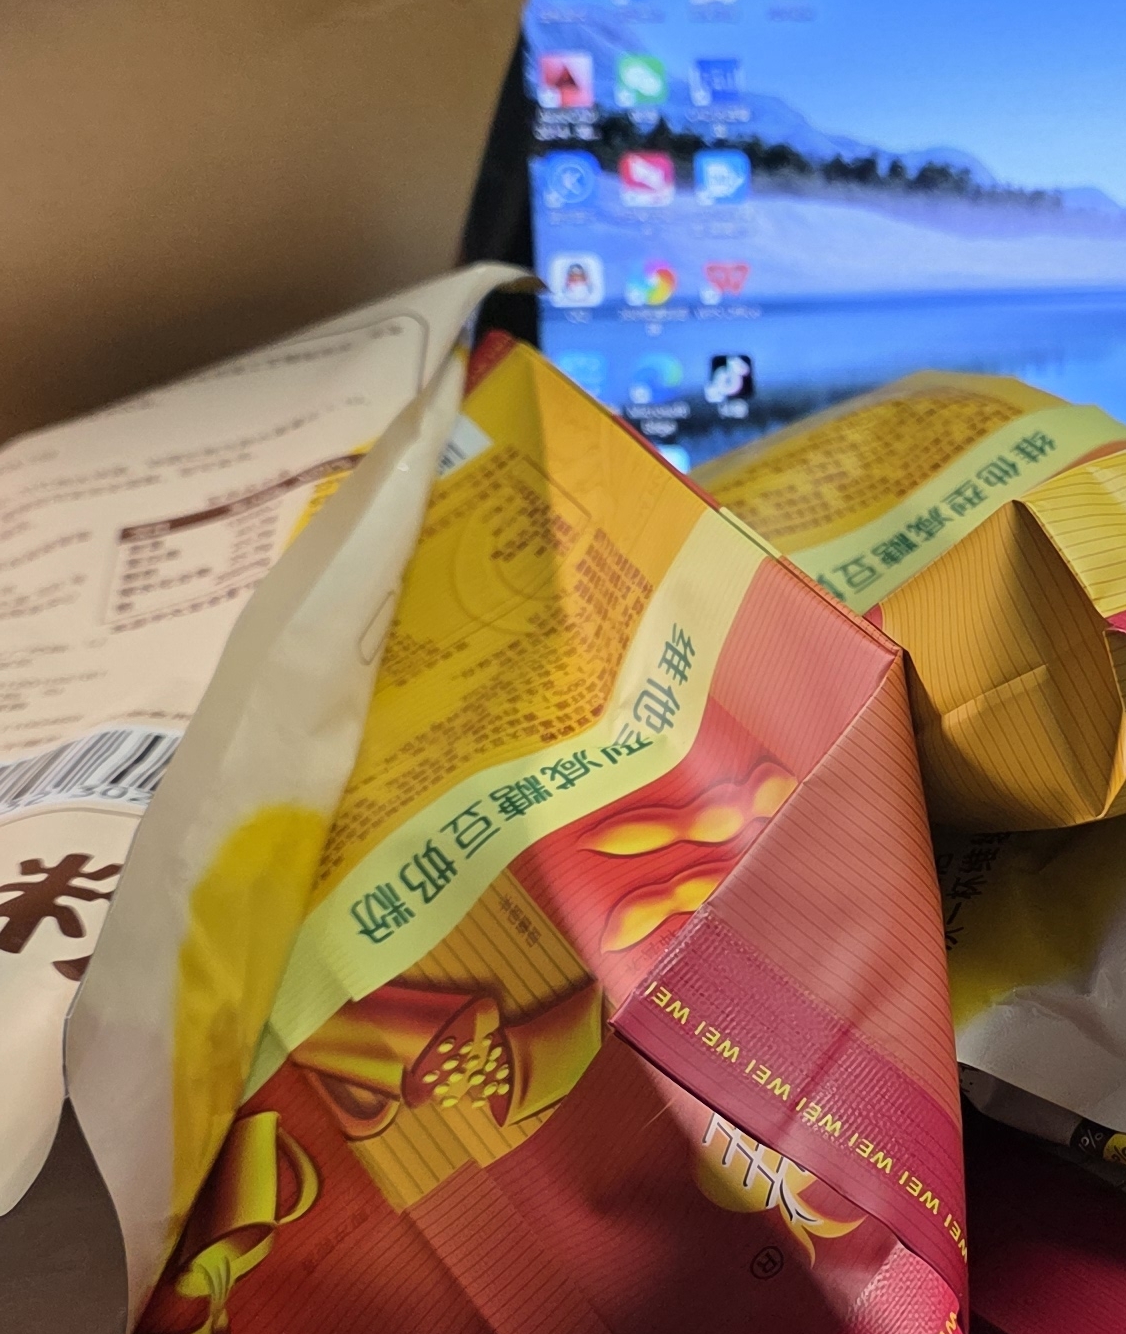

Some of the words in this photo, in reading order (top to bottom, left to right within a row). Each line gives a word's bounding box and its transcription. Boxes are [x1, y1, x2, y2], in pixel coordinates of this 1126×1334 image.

[350, 622, 695, 944] 维他型减糖豆奶粉
[645, 980, 690, 1025] WEI
[694, 1020, 739, 1063] WEI
[744, 1059, 791, 1101] WEI
[796, 1097, 842, 1138] WEI
[848, 1133, 893, 1174] WEI
[898, 1170, 940, 1215] WEI
